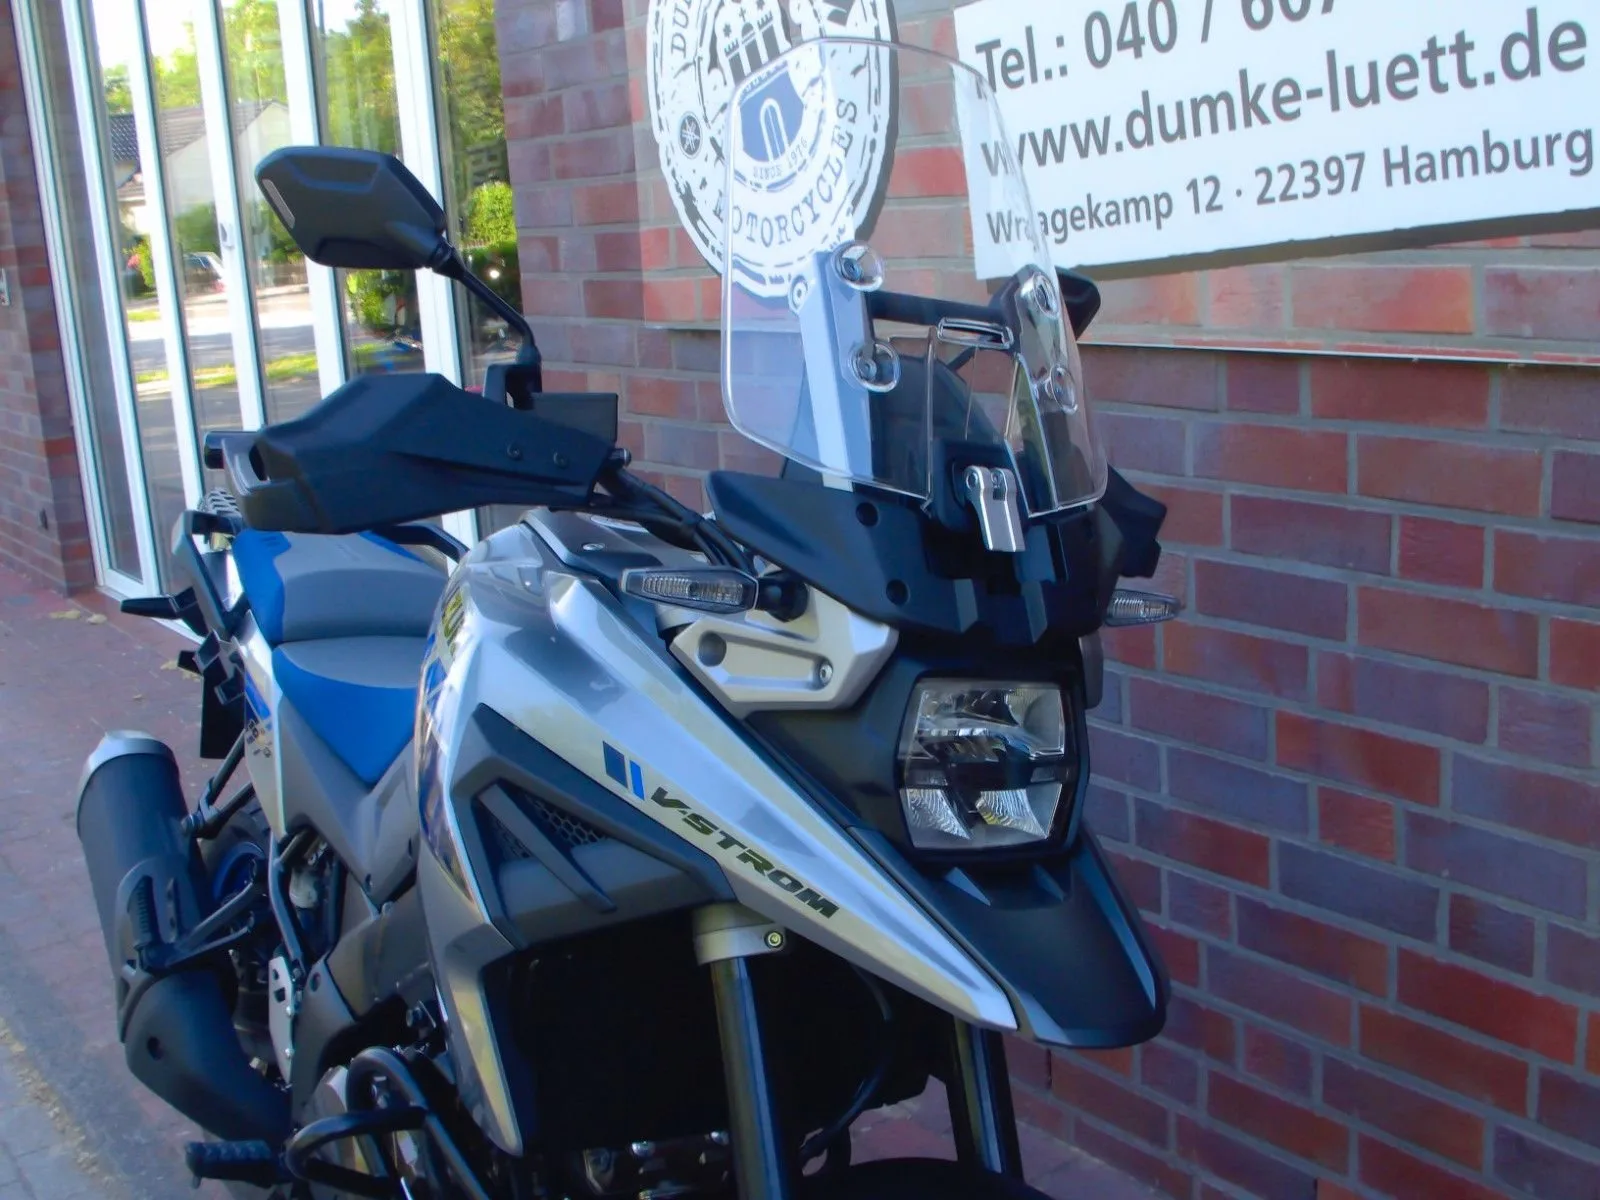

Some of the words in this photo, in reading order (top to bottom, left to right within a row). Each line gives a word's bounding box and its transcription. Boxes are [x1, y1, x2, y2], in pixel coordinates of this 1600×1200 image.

[974, 25, 1069, 94] Tel.:
[1084, 0, 1178, 69] 040
[980, 6, 1588, 177] www.dumke-luett.de
[1186, 174, 1224, 214] 12
[1254, 151, 1366, 206] 22397
[1383, 128, 1594, 188] Hamburg
[650, 786, 840, 919] V-STROM
